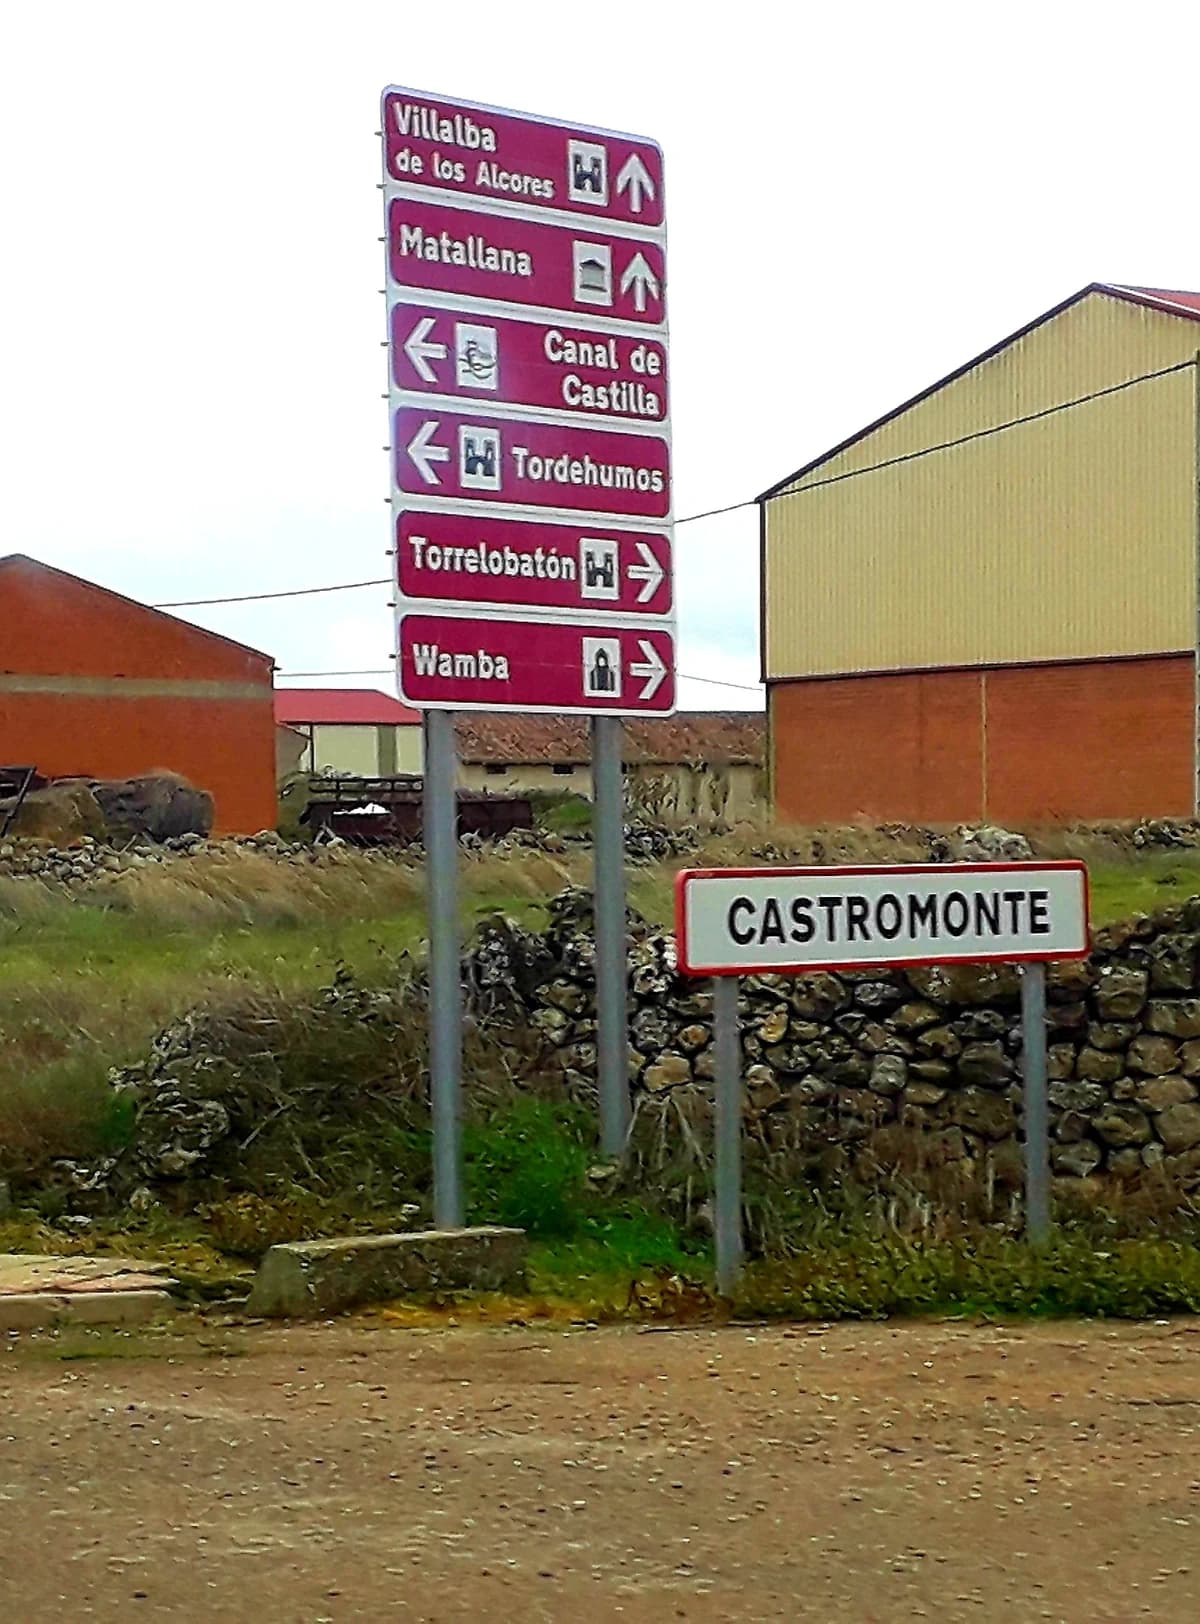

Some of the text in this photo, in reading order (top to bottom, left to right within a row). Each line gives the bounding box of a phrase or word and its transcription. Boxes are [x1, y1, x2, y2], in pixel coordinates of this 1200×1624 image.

[393, 101, 496, 151] Villalba
[395, 149, 555, 198] de los Alcores
[400, 223, 533, 277] Matallana
[544, 330, 661, 375] Canal de
[562, 374, 661, 416] Castilla
[511, 447, 664, 492] Tordehumos
[408, 536, 577, 581] Torrelobatón
[412, 643, 509, 680] Wamba
[728, 890, 1050, 946] CASTROMONTE
